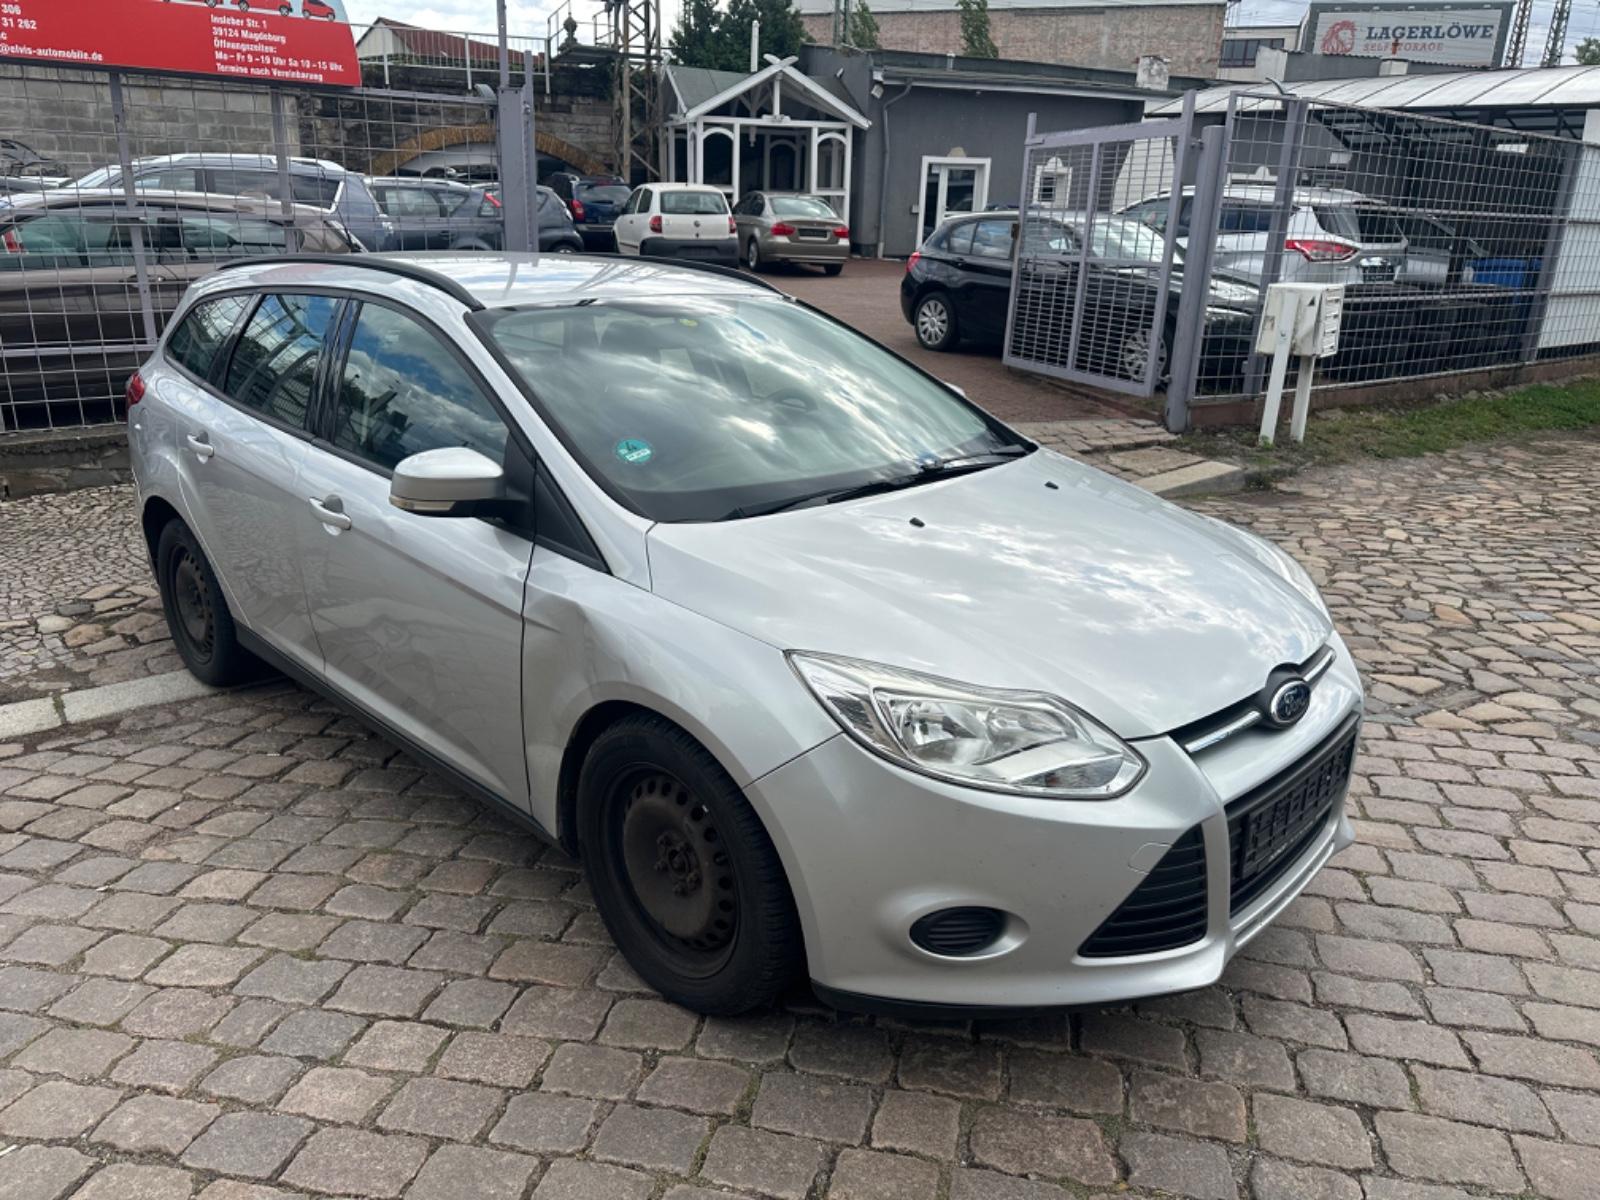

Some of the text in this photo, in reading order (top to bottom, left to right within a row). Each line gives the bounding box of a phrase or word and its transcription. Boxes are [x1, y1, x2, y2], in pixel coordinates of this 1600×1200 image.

[1, 17, 14, 28] 31
[1366, 22, 1494, 40] LAGERLÖWE
[212, 26, 286, 45] 39124 Magdeburg
[214, 37, 277, 54] Öffnungszeiten:
[1363, 42, 1444, 52] SELFTORAGE
[215, 50, 228, 60] Mo
[272, 56, 287, 66] Uhr
[288, 57, 299, 67] Sa
[216, 63, 323, 82] Termine nach Vereinbarung
